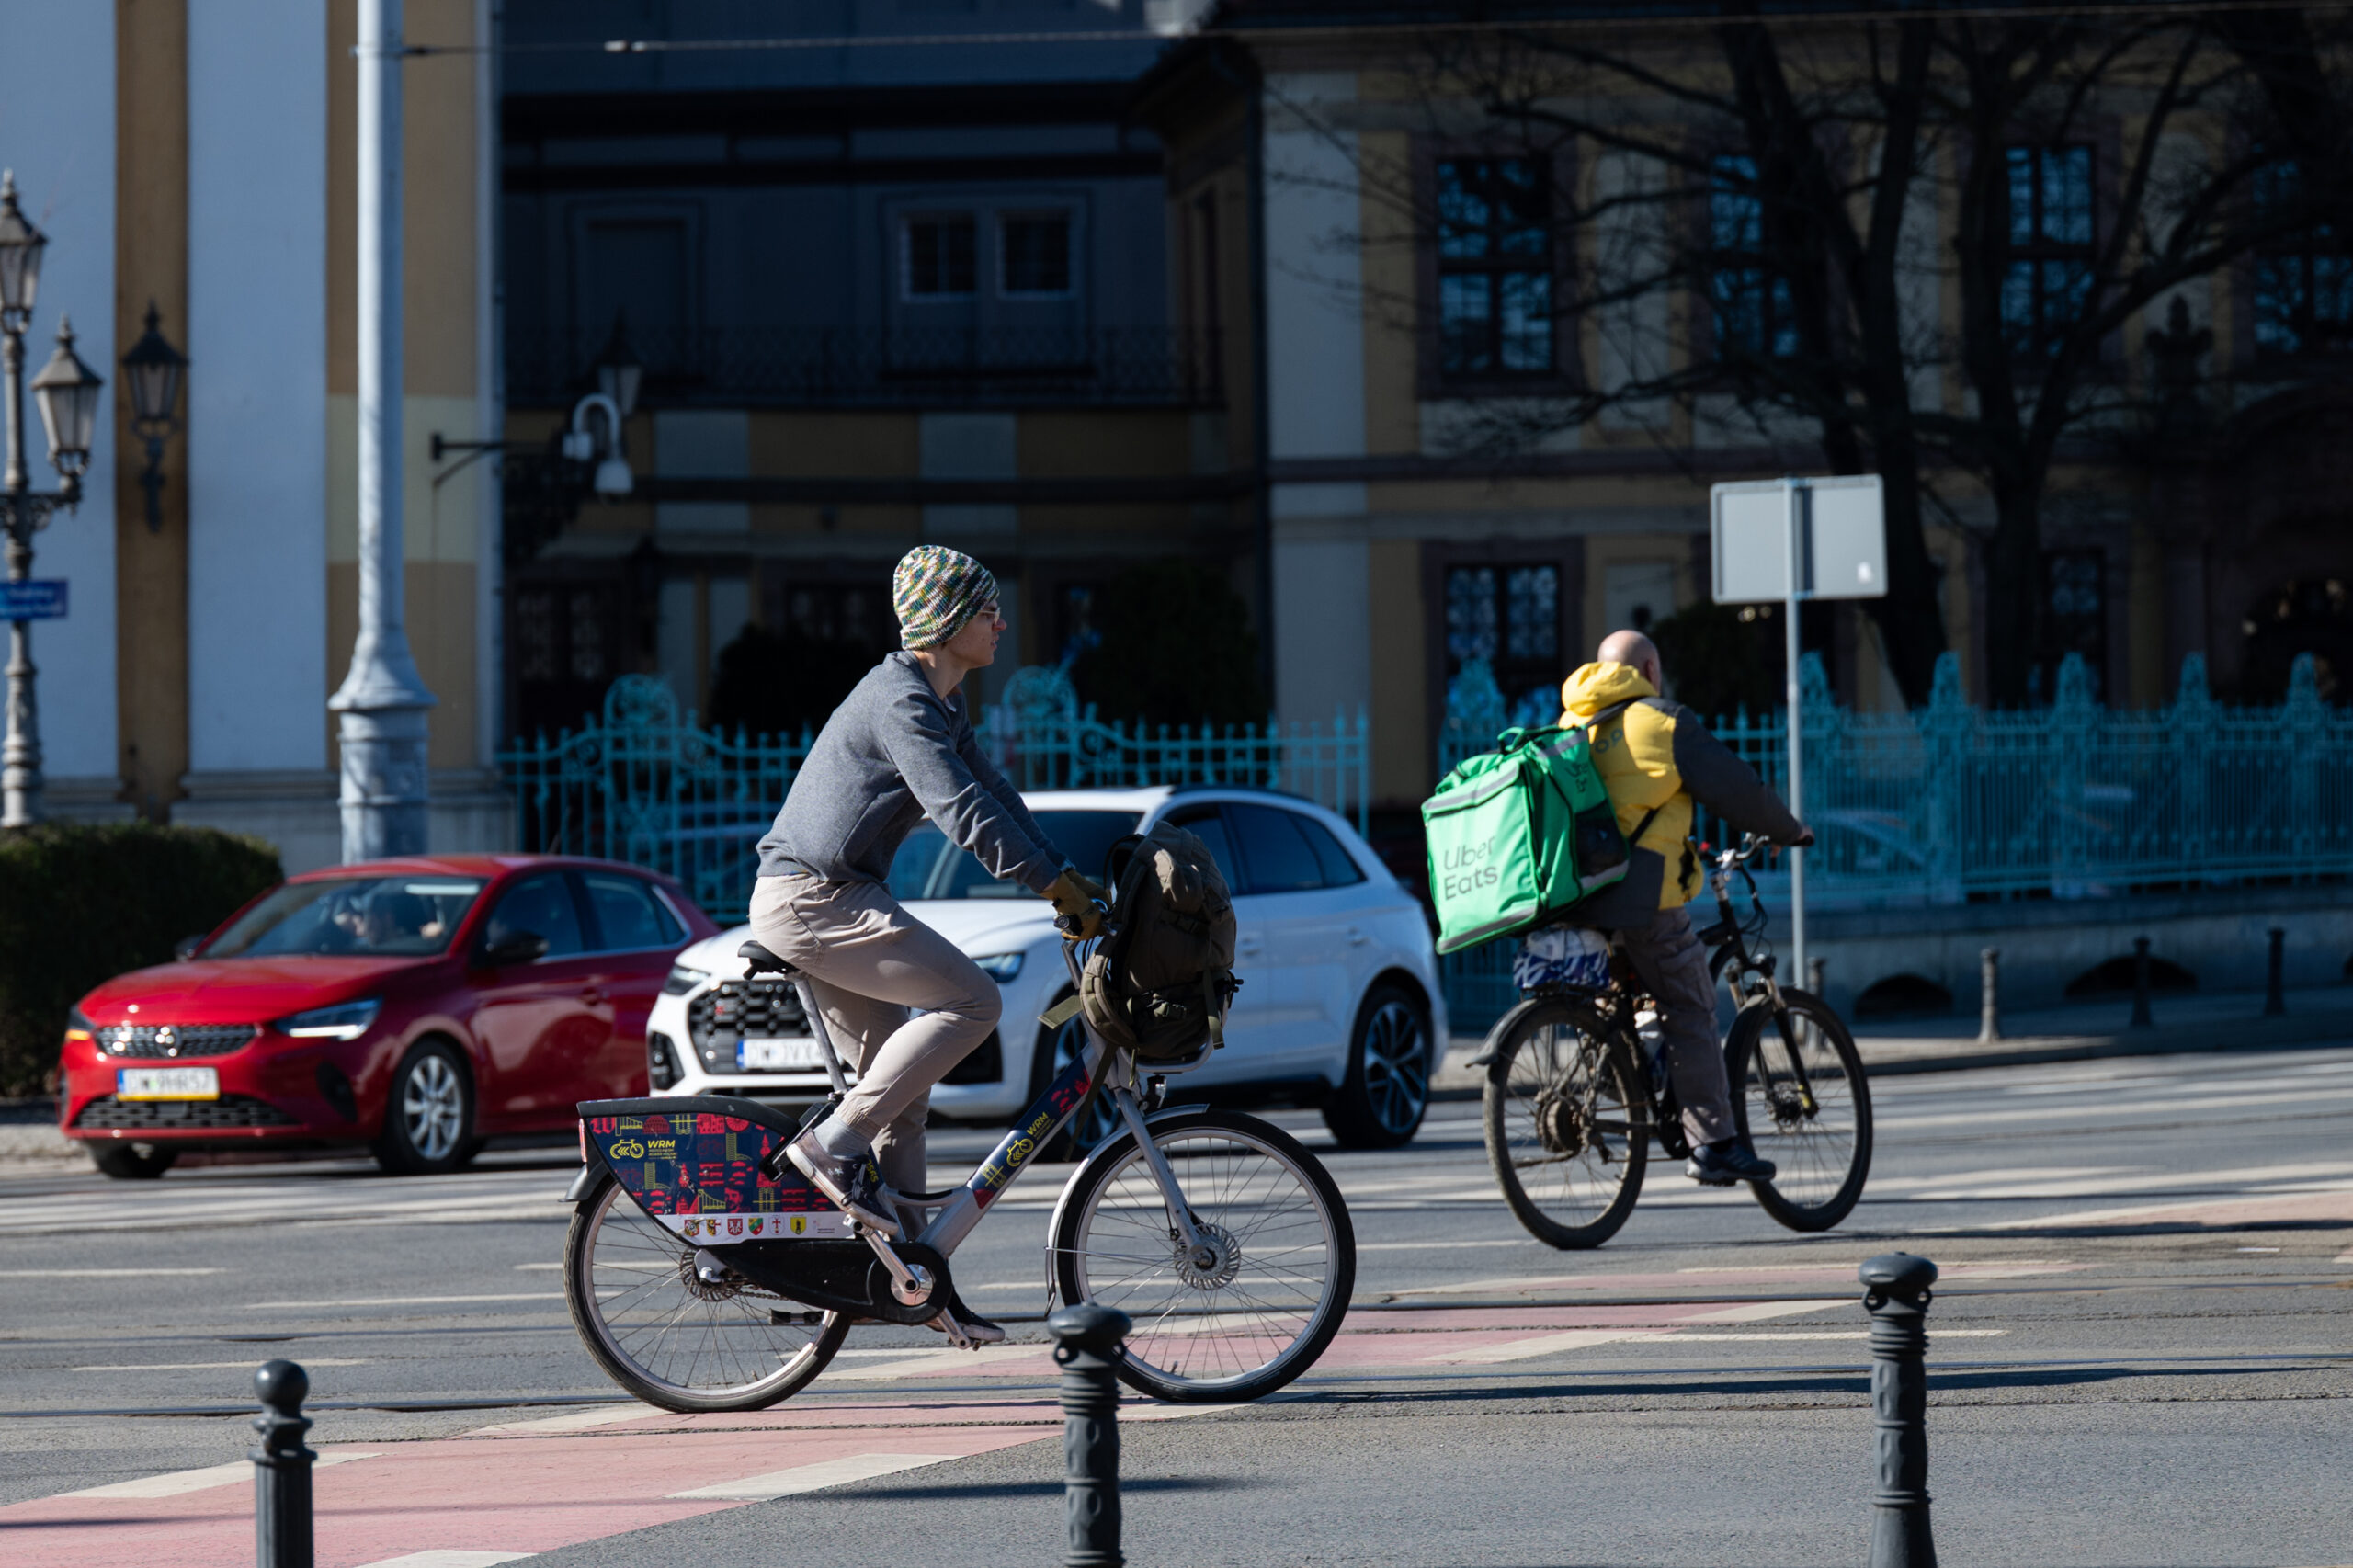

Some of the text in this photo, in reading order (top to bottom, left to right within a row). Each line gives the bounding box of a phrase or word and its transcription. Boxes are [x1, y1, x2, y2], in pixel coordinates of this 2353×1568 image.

[1444, 835, 1495, 870] Uber
[1444, 866, 1498, 901] Eats
[1026, 1111, 1049, 1135] WRM
[647, 1140, 676, 1149] WRM
